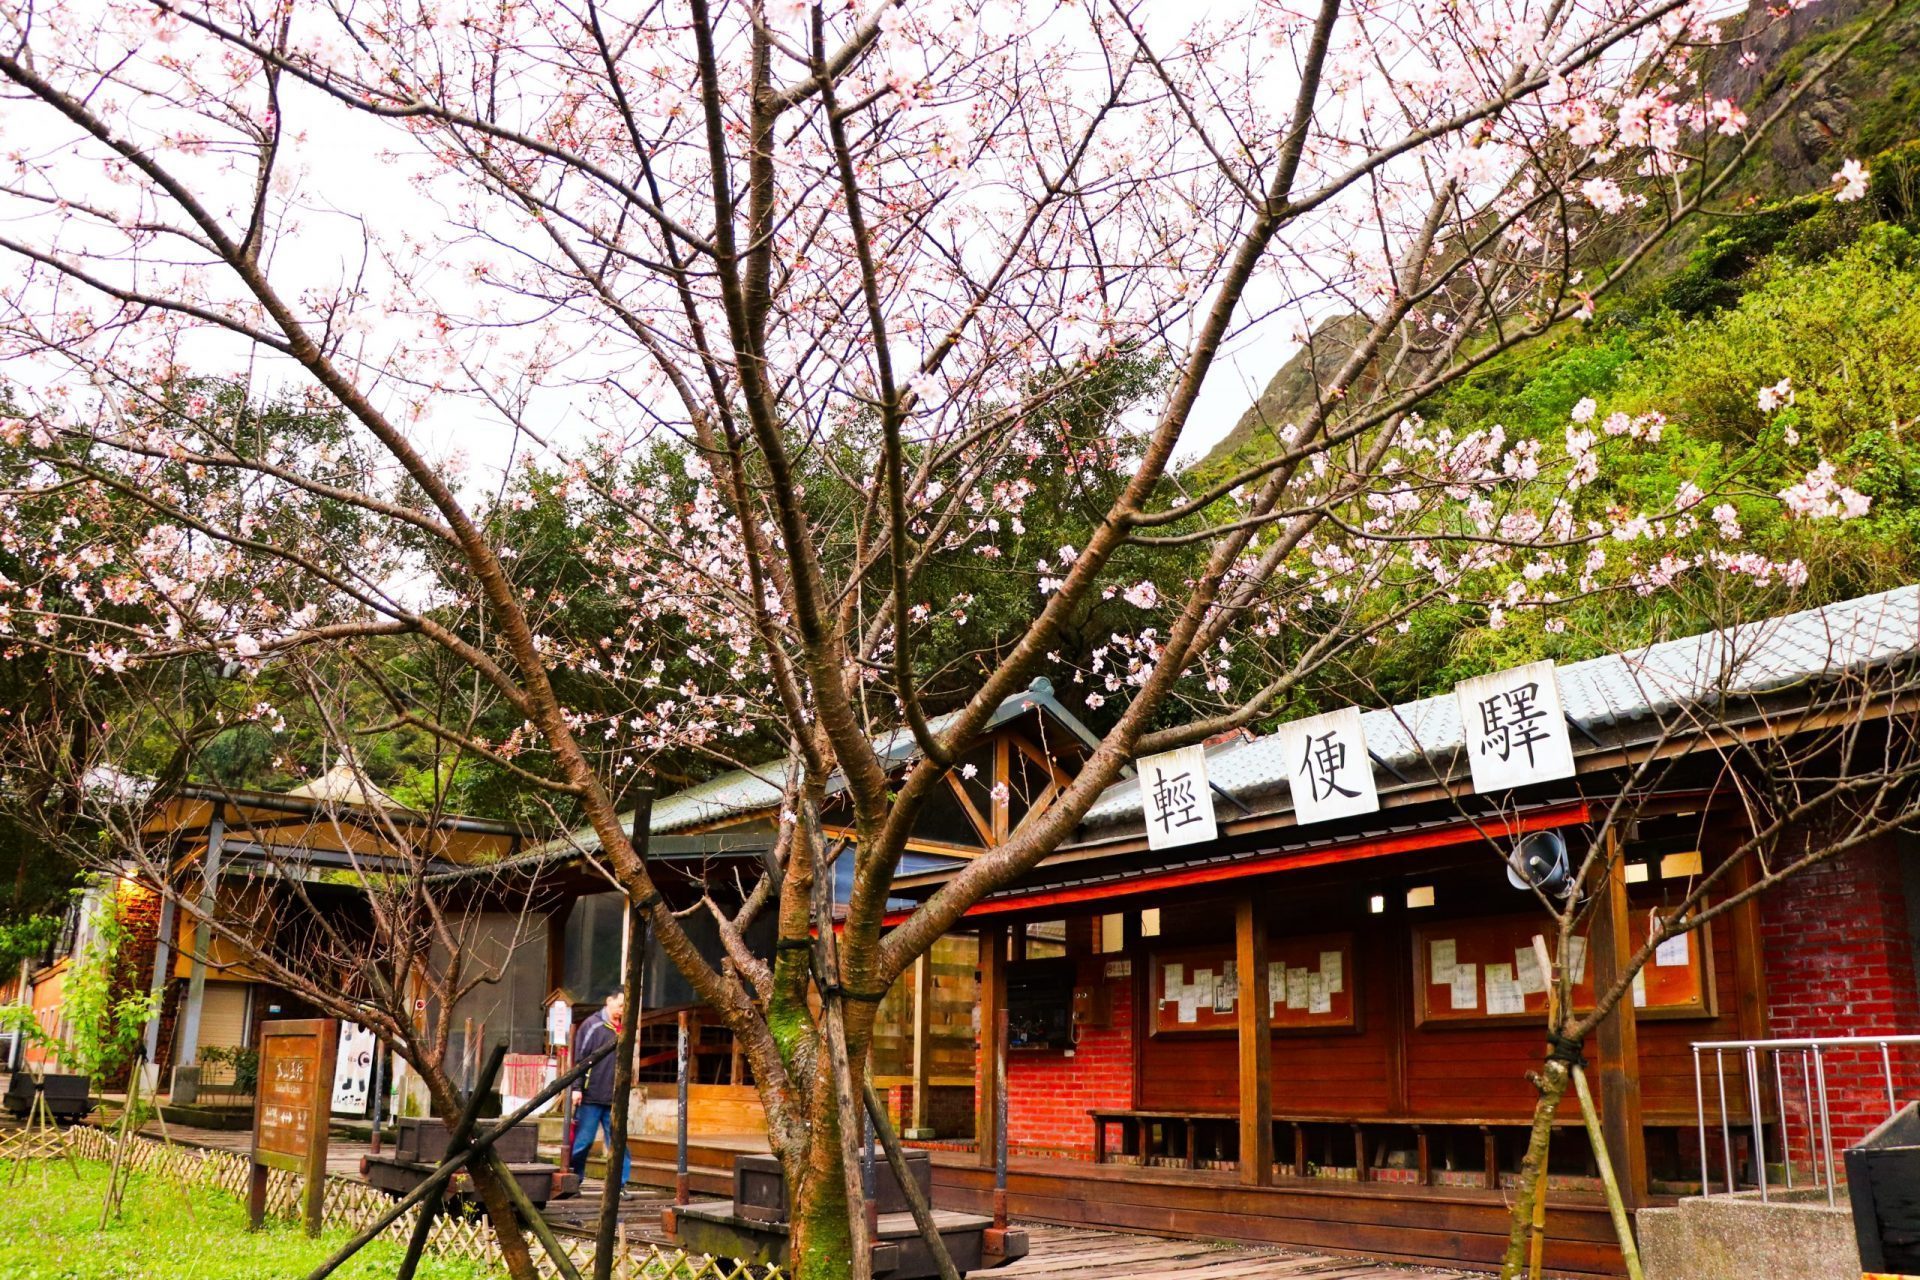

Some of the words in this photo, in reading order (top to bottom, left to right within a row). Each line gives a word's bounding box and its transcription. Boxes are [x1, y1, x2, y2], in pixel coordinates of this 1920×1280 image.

[1153, 767, 1203, 834] 輕
[1299, 730, 1362, 803] 便
[1480, 681, 1551, 769] 驛
